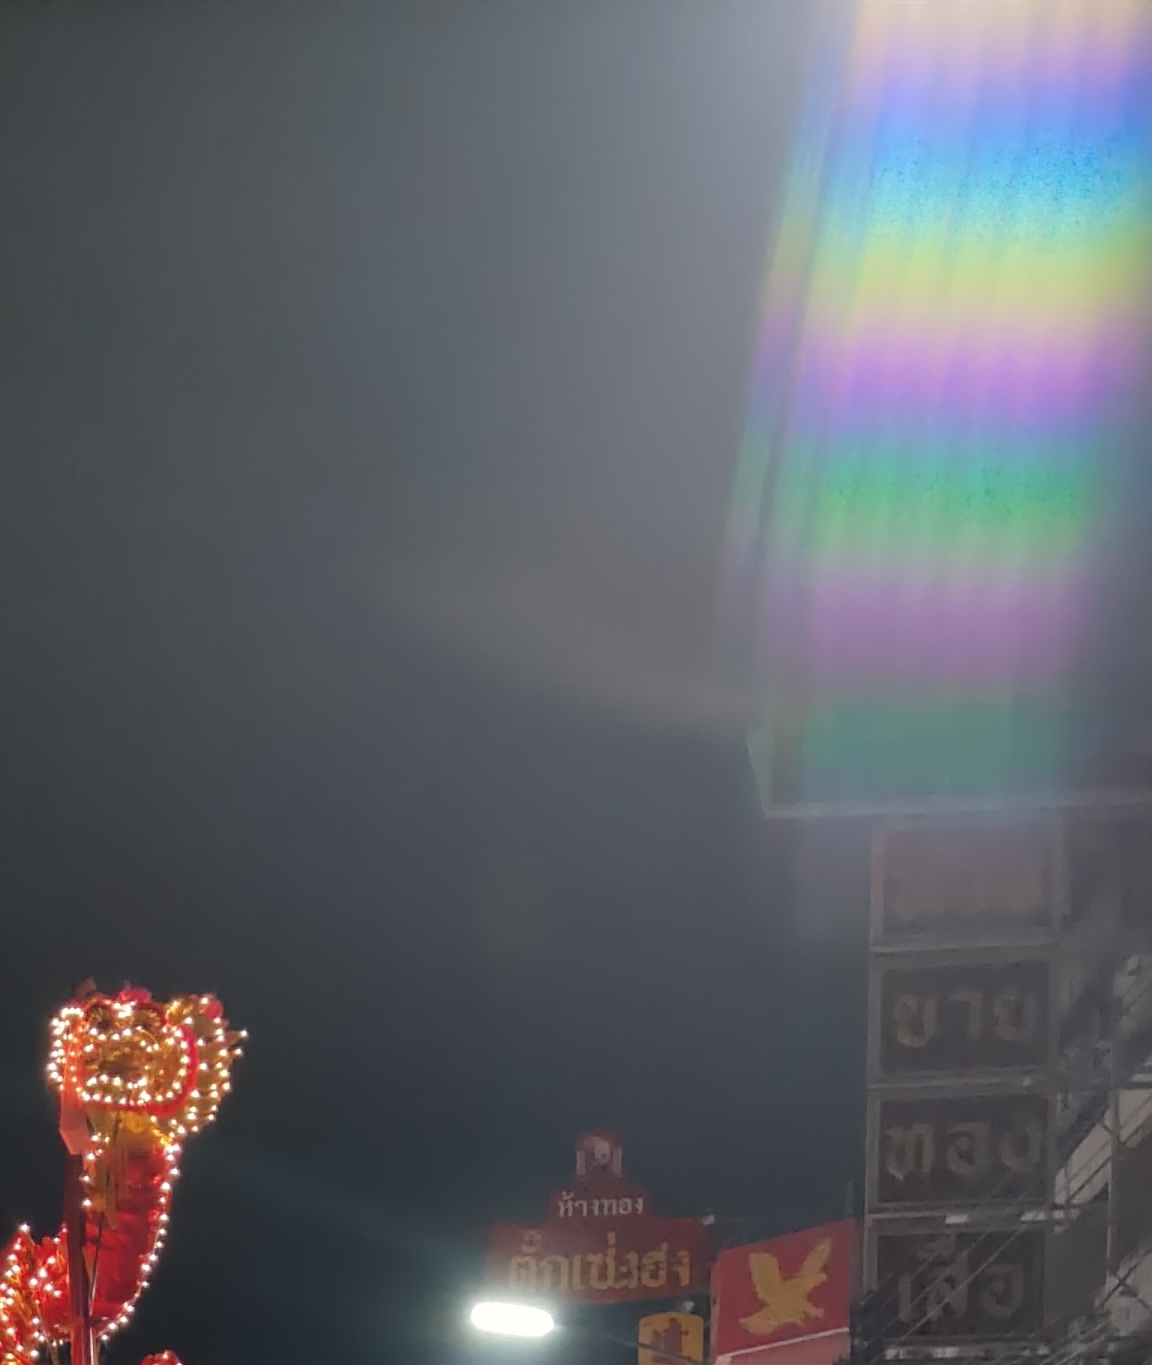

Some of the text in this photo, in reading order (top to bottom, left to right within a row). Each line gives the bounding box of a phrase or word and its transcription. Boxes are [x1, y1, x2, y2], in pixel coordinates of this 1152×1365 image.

[892, 987, 1038, 1048] ขาย
[886, 1120, 1042, 1181] ทอง
[557, 1191, 645, 1218] ห้างทอง
